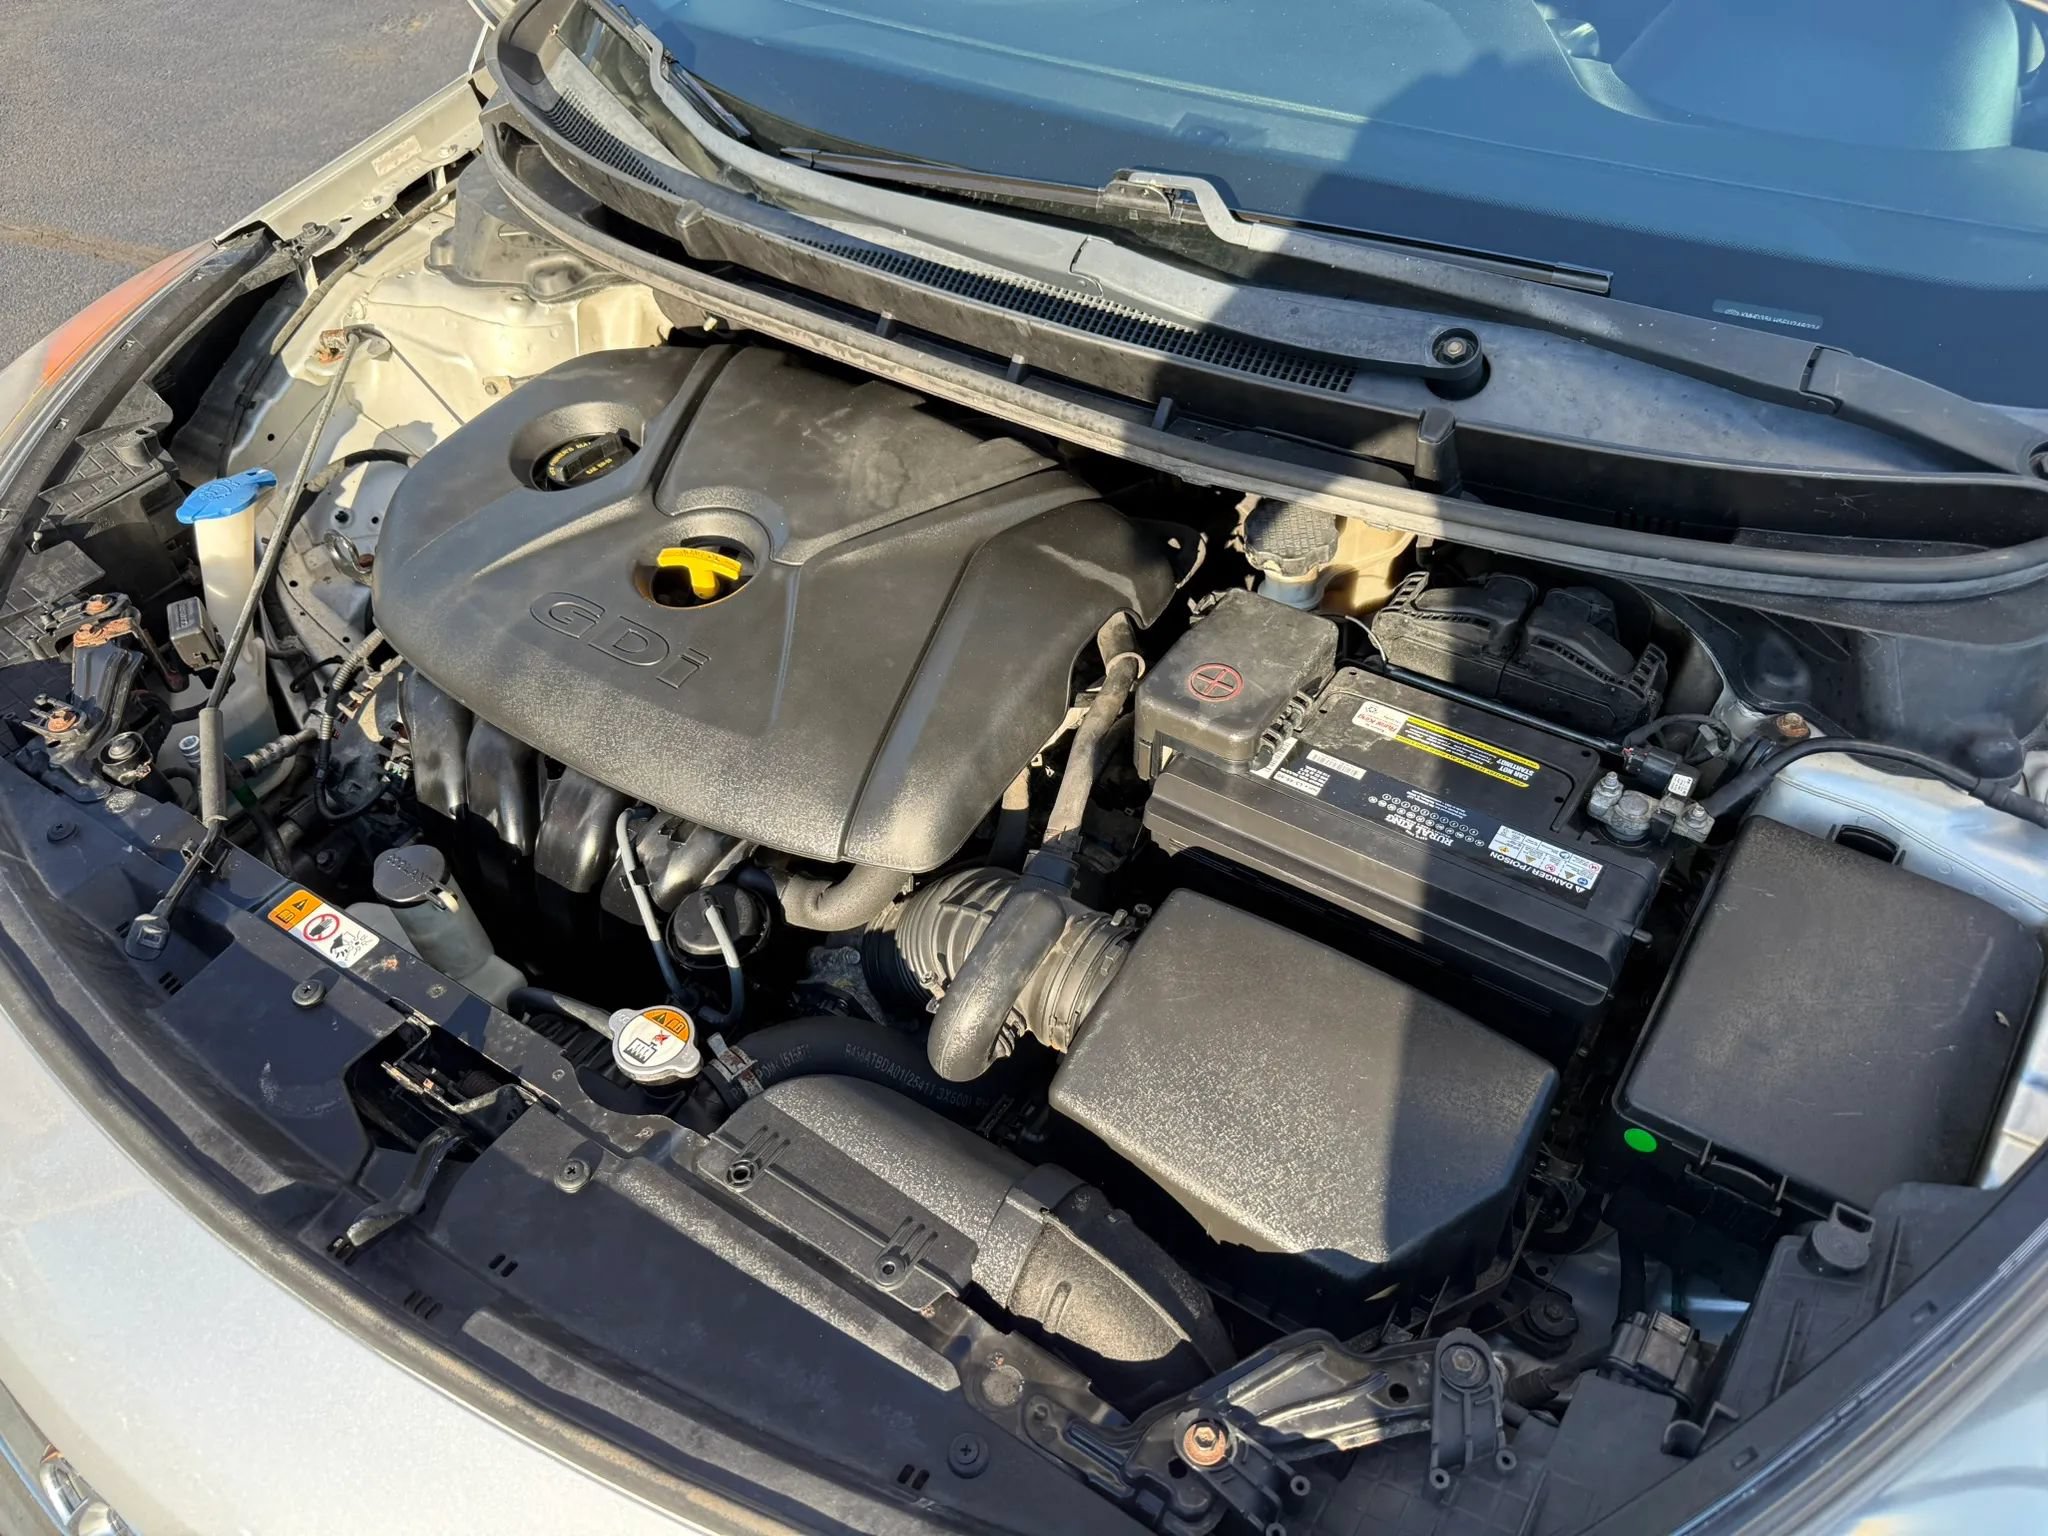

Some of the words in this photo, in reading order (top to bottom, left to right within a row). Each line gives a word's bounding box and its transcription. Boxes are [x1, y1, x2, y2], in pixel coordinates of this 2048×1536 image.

[530, 592, 712, 690] GDi
[1495, 757, 1534, 776] STARTING?
[1497, 765, 1513, 774] NOT
[1513, 770, 1528, 780] CAR
[1383, 813, 1413, 829] KING
[1414, 824, 1453, 846] RURAL
[1489, 851, 1526, 870] POISON
[1531, 867, 1573, 889] DANGER
